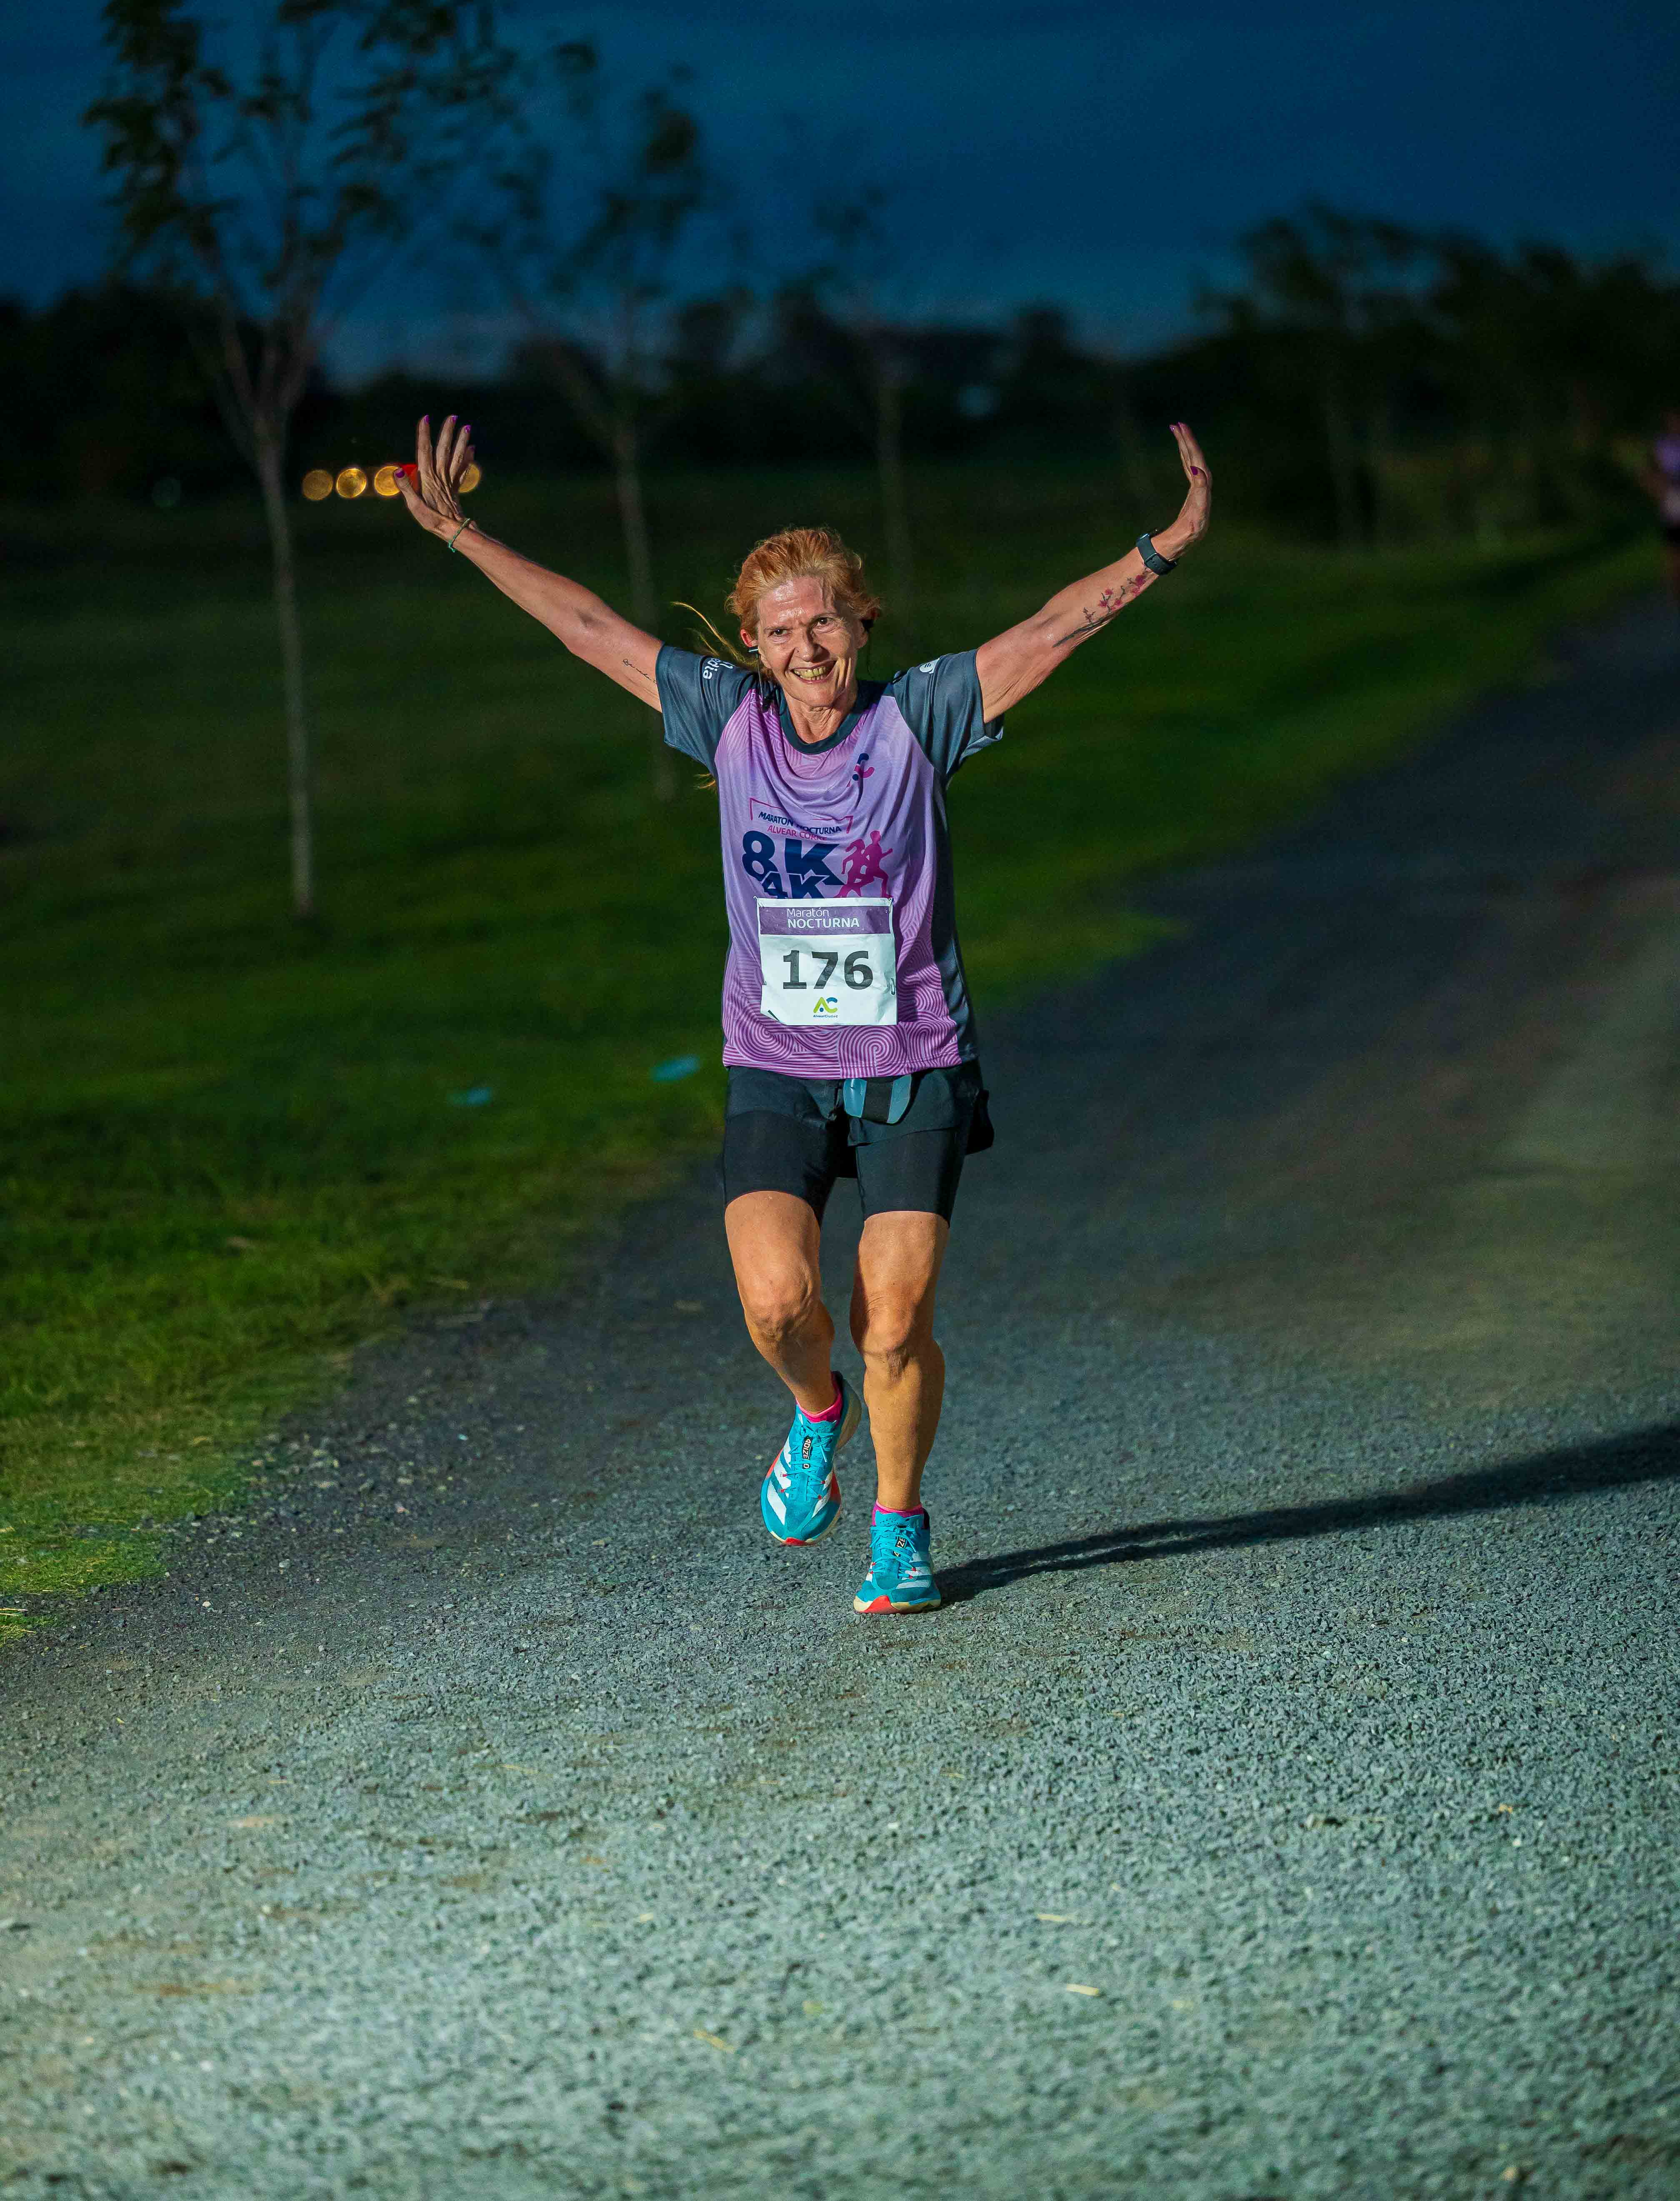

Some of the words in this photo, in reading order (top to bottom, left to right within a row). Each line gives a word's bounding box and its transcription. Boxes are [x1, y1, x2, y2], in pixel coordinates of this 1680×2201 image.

[767, 825, 797, 837] ALVEAR
[742, 830, 846, 886] 8K
[787, 908, 829, 917] Maratón
[787, 917, 860, 929] NOCTURNA
[783, 950, 873, 990] 176
[802, 1439, 811, 1469] ADIZEO
